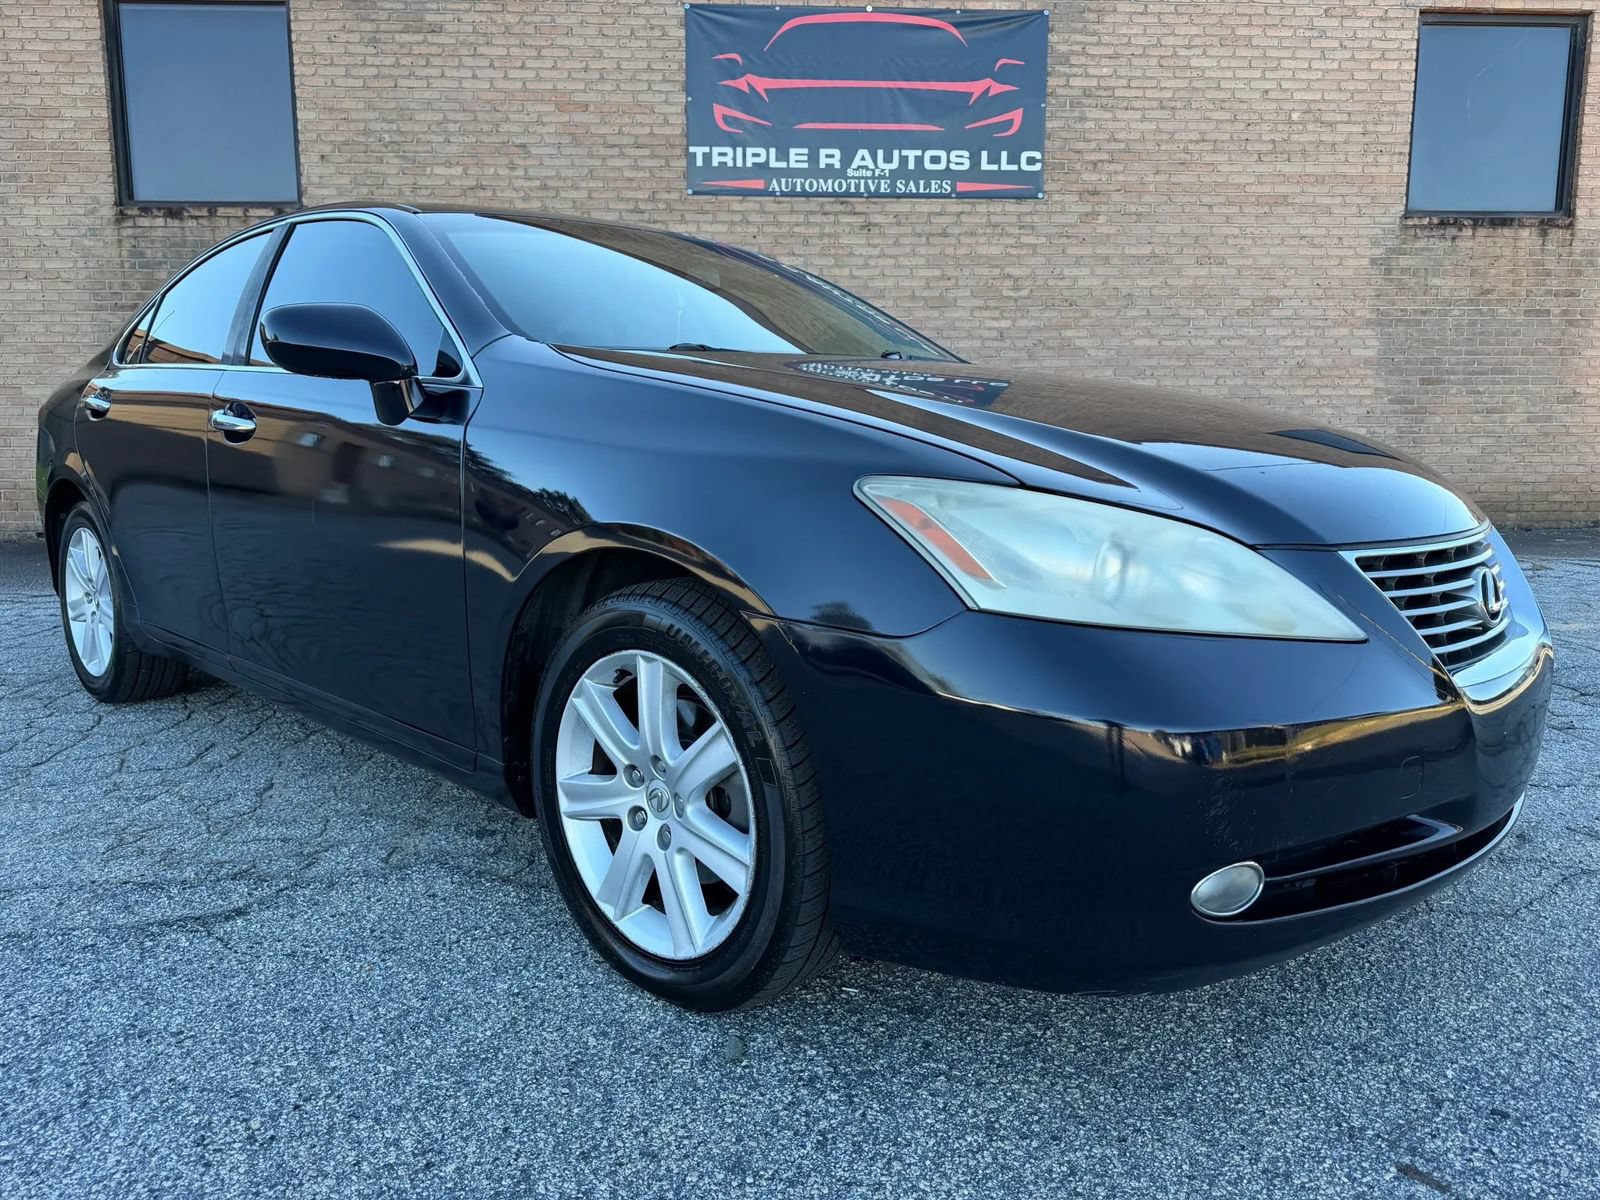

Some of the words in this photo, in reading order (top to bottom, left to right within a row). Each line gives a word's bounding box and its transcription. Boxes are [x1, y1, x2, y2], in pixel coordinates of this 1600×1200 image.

[688, 146, 809, 168] TRIPLE
[819, 148, 841, 169] R
[850, 149, 970, 171] AUTOS
[980, 150, 1042, 171] LLC
[846, 168, 872, 177] Suite
[875, 168, 889, 177] F-1
[768, 177, 891, 193] AUTOMOTIVE
[896, 179, 951, 194] SALES
